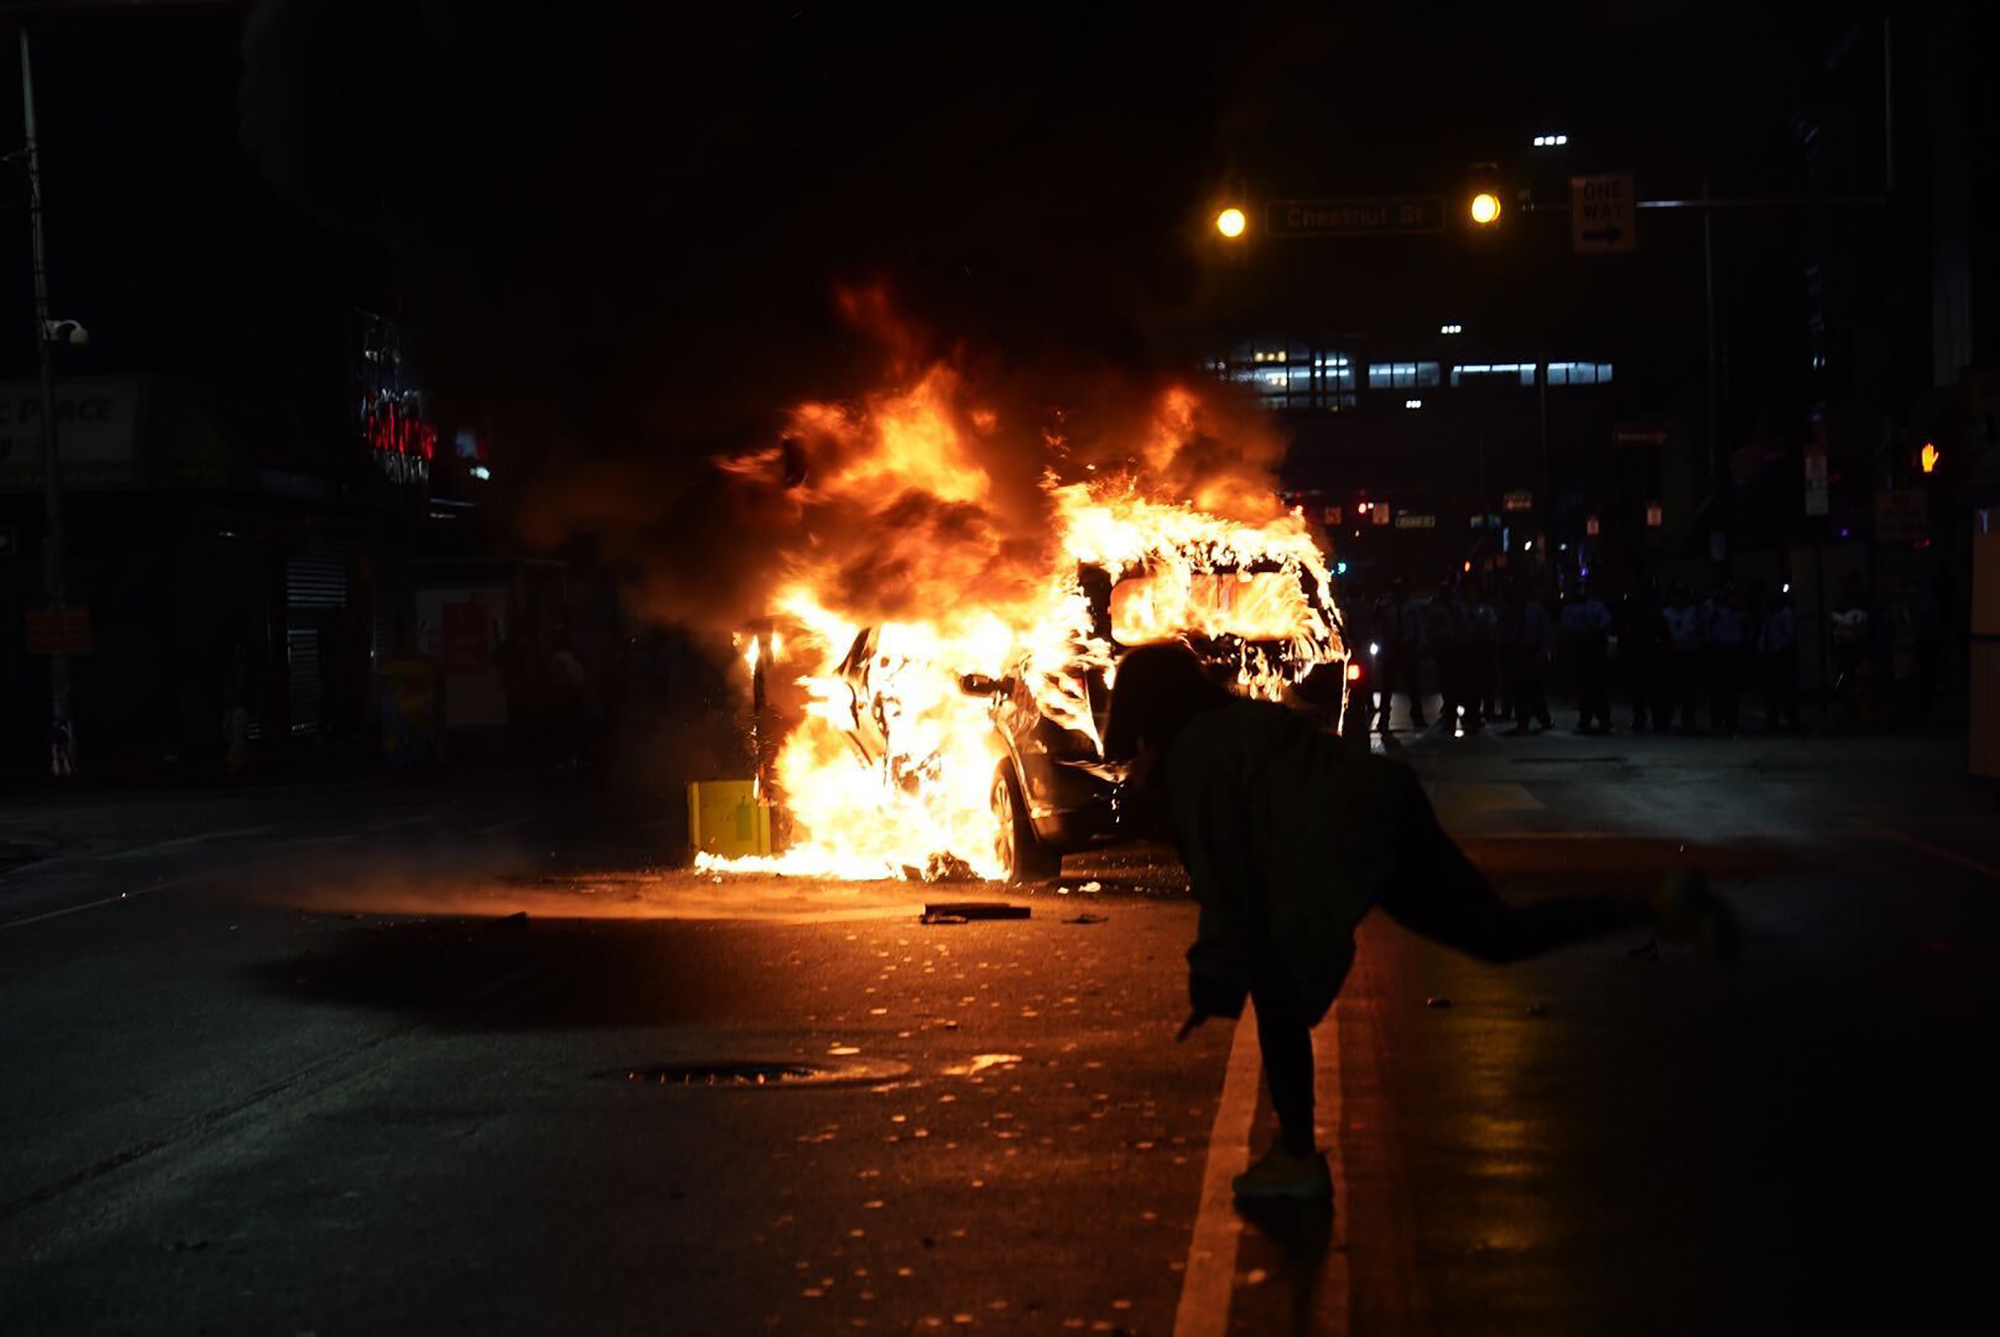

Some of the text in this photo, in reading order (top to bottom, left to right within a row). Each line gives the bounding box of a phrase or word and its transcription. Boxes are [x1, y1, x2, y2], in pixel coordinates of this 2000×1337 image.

[1584, 180, 1623, 200] ONE
[1287, 204, 1424, 229] Chestnut St
[1584, 203, 1623, 219] WAY
[19, 398, 113, 424] PACE
